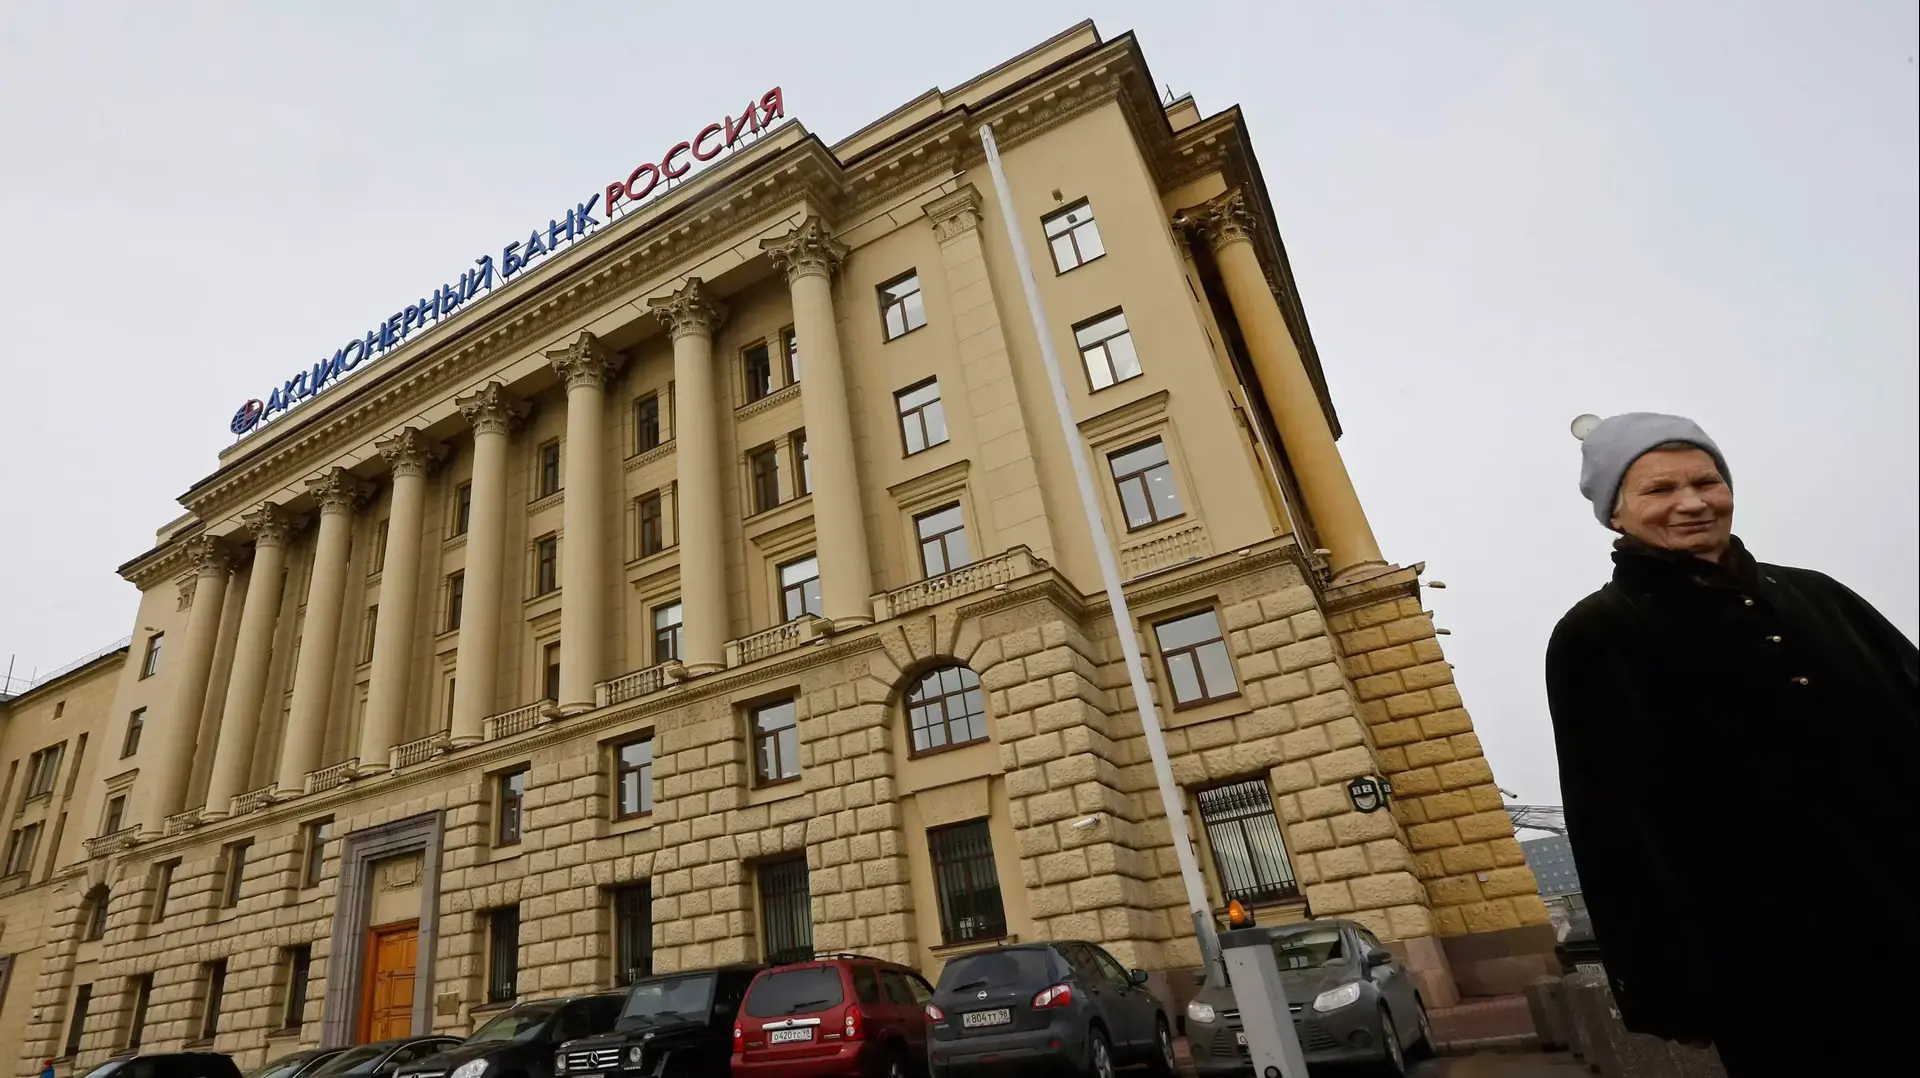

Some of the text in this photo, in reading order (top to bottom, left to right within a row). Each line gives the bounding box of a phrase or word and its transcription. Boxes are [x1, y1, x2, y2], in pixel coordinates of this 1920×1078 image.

[261, 86, 785, 420] АКЦИОНЕРНЫЙ БАНК РОССИЯ
